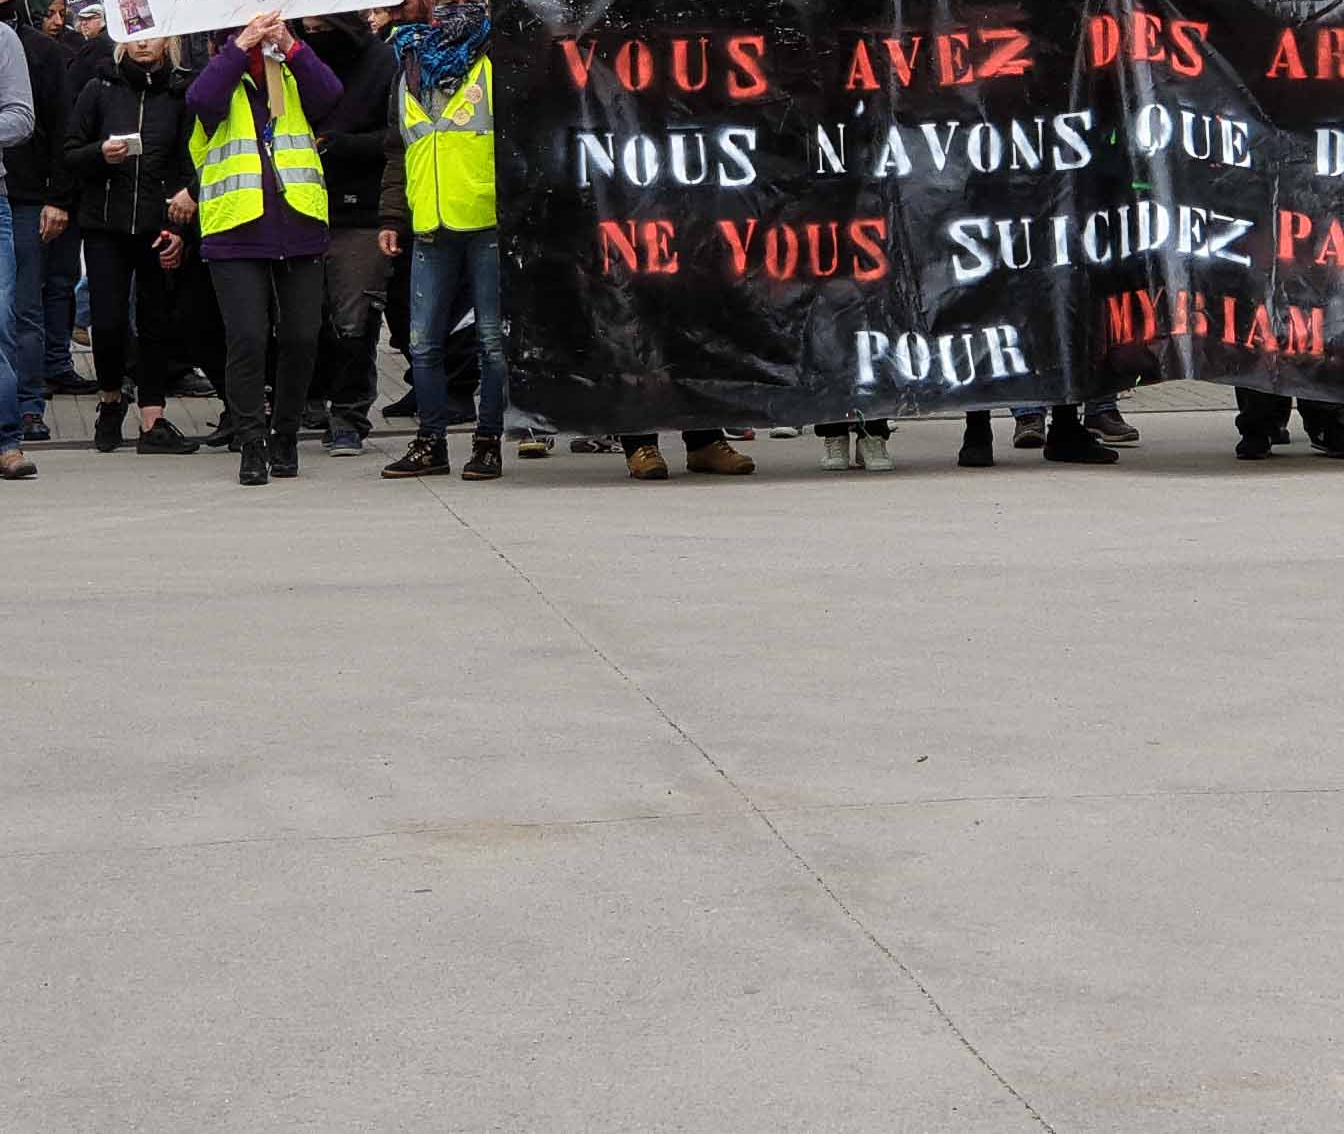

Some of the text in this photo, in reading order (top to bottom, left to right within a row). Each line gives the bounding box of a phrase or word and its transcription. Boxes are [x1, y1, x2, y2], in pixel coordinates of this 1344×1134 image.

[561, 35, 768, 99] VOUS
[847, 28, 1034, 90] AVEZ
[1089, 10, 1208, 77] DES
[578, 128, 757, 187] NOUS
[1136, 103, 1251, 168] QUE
[599, 219, 679, 275] NE
[719, 218, 888, 281] VOUS
[948, 200, 1254, 282] SUICIDEZ
[856, 323, 1029, 388] POUR
[1108, 289, 1325, 357] MYRIAM
